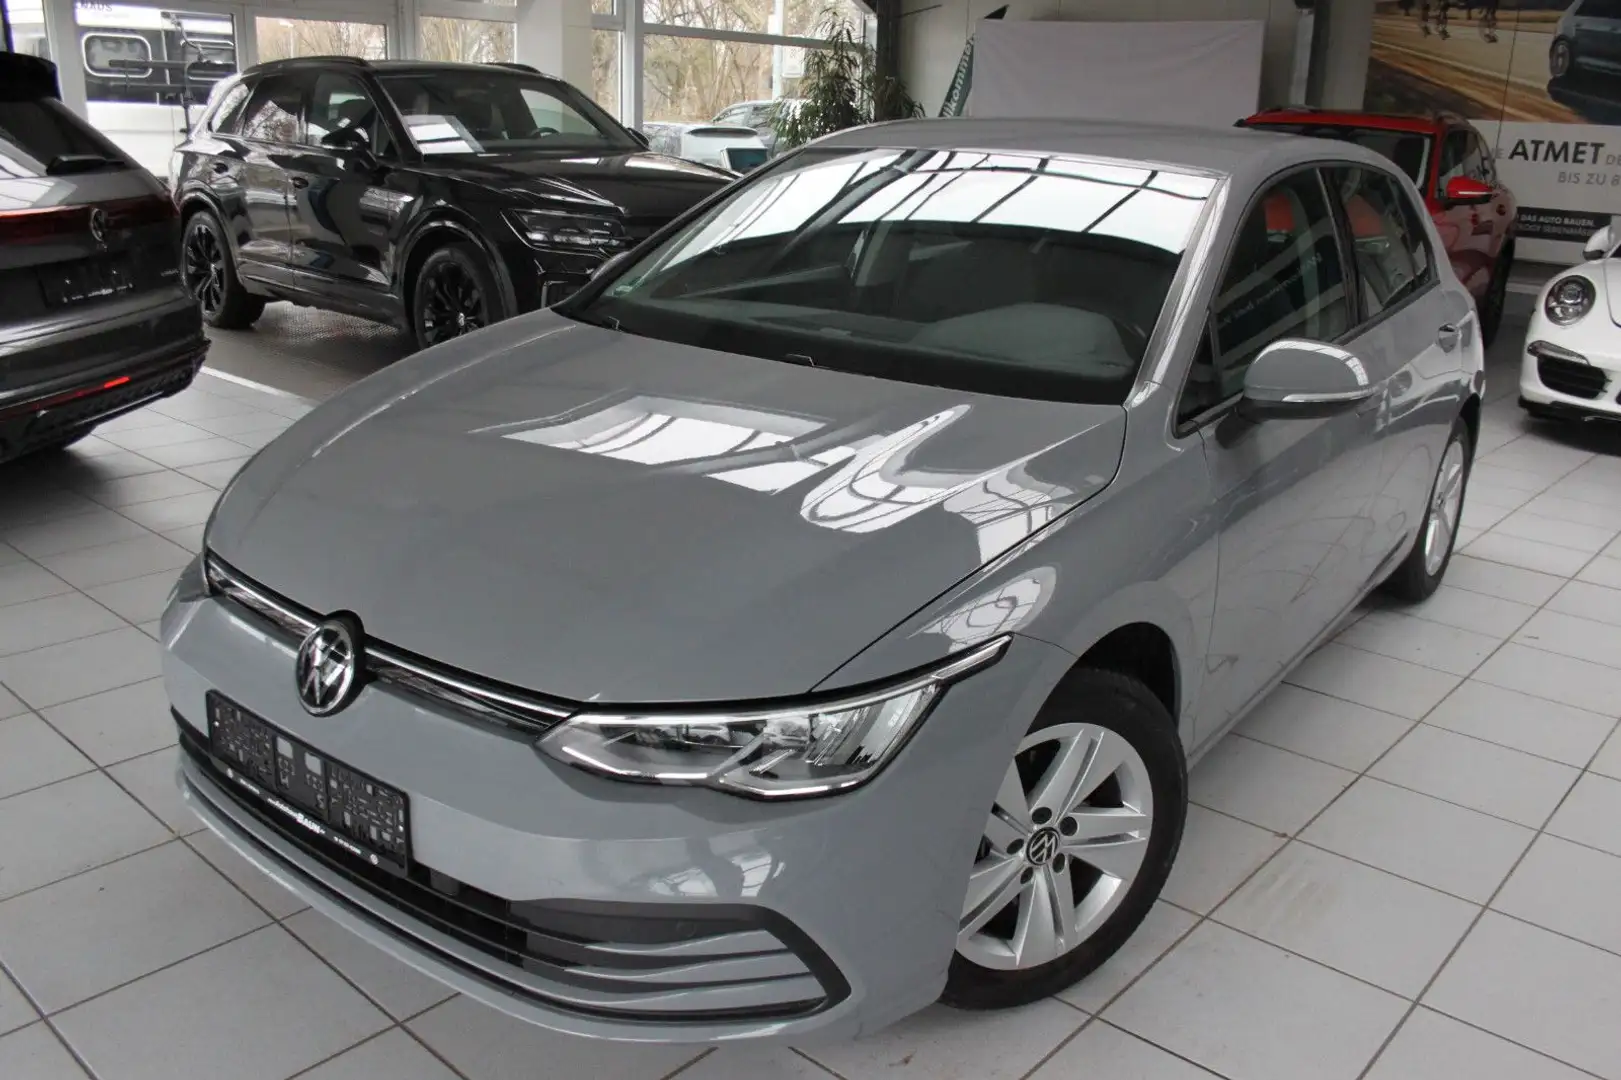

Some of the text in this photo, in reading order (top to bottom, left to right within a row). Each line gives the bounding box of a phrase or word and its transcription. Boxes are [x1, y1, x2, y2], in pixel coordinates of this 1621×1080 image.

[1508, 139, 1605, 164] ATMET
[1558, 171, 1581, 184] BIS
[1586, 173, 1607, 186] ZU
[1538, 215, 1562, 224] AUTO
